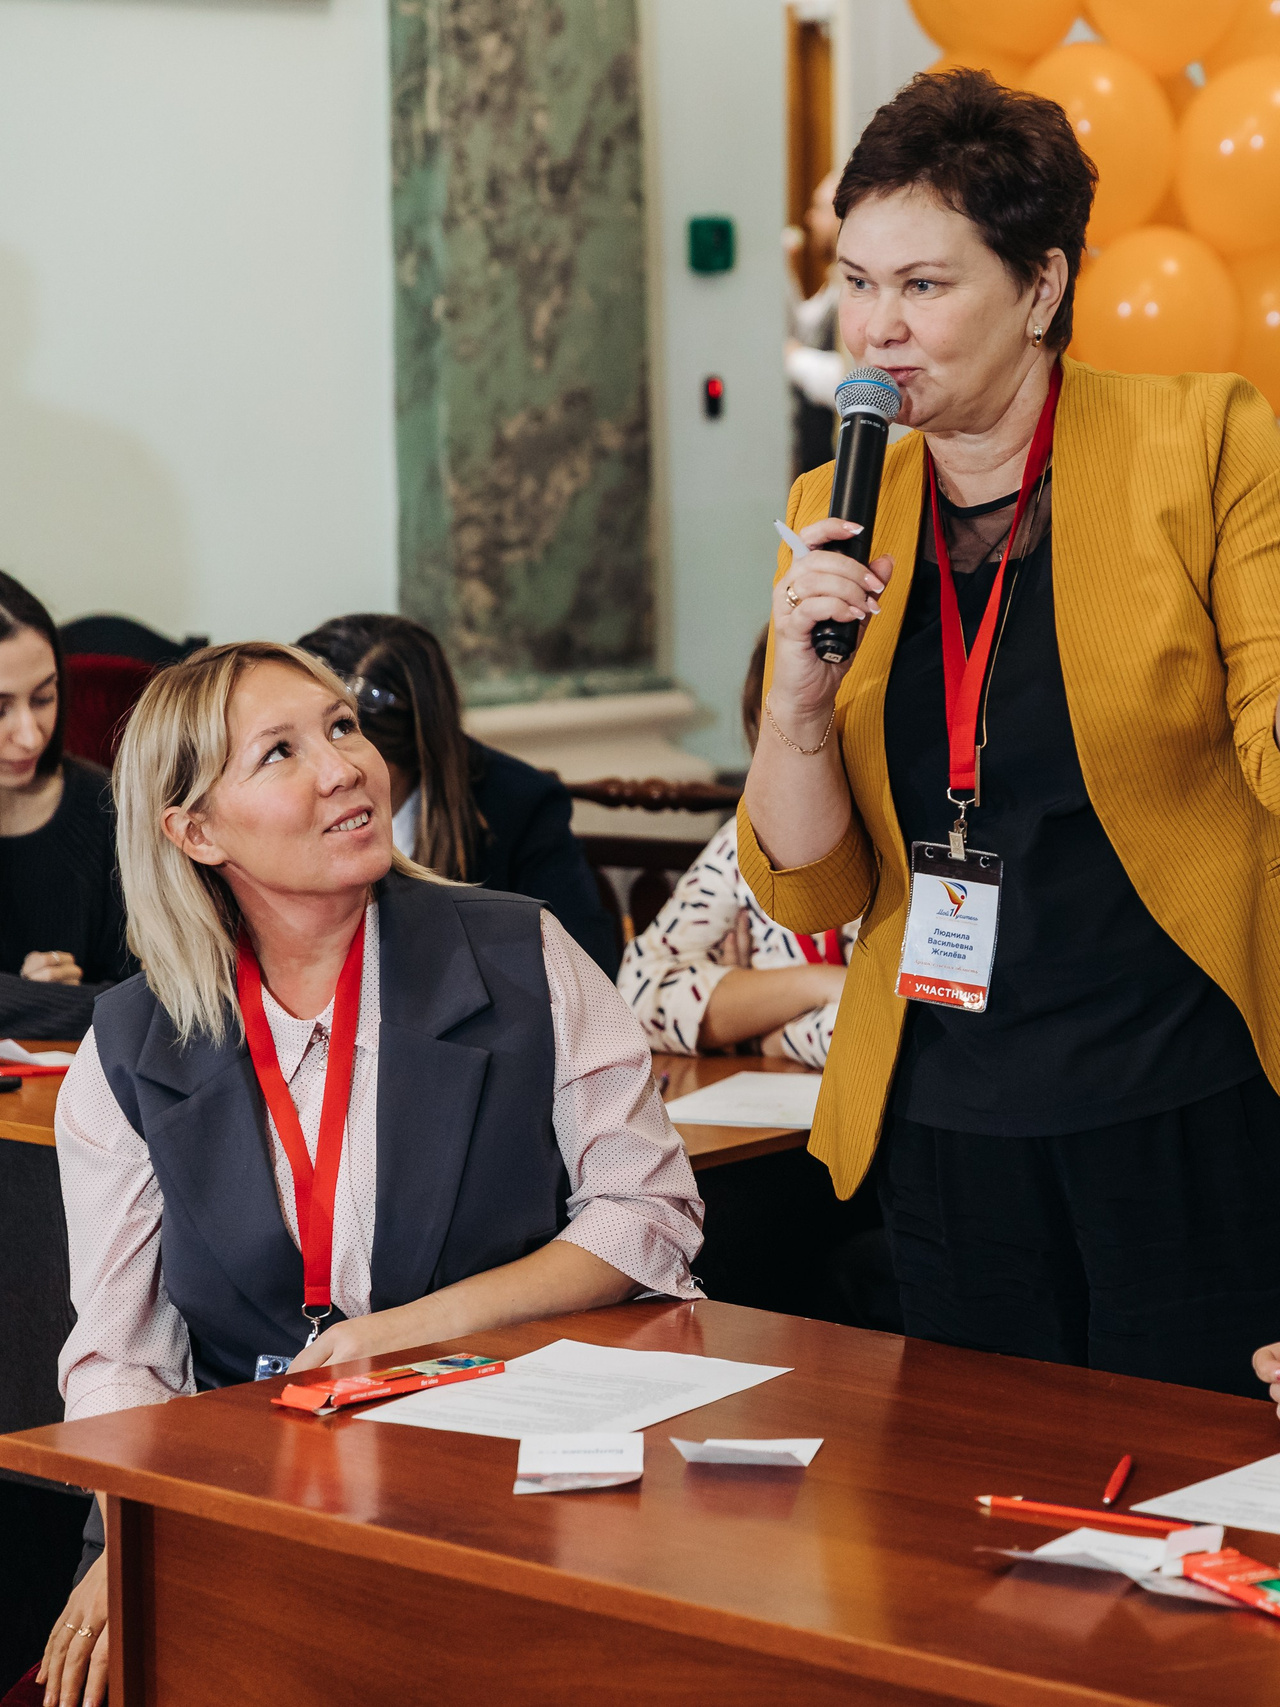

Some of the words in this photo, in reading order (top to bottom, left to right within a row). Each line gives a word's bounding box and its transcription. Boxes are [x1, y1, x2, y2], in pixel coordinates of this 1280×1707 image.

[933, 928, 970, 941] Людмила
[927, 937, 974, 951] Васильевна
[931, 947, 967, 960] Жгилёва
